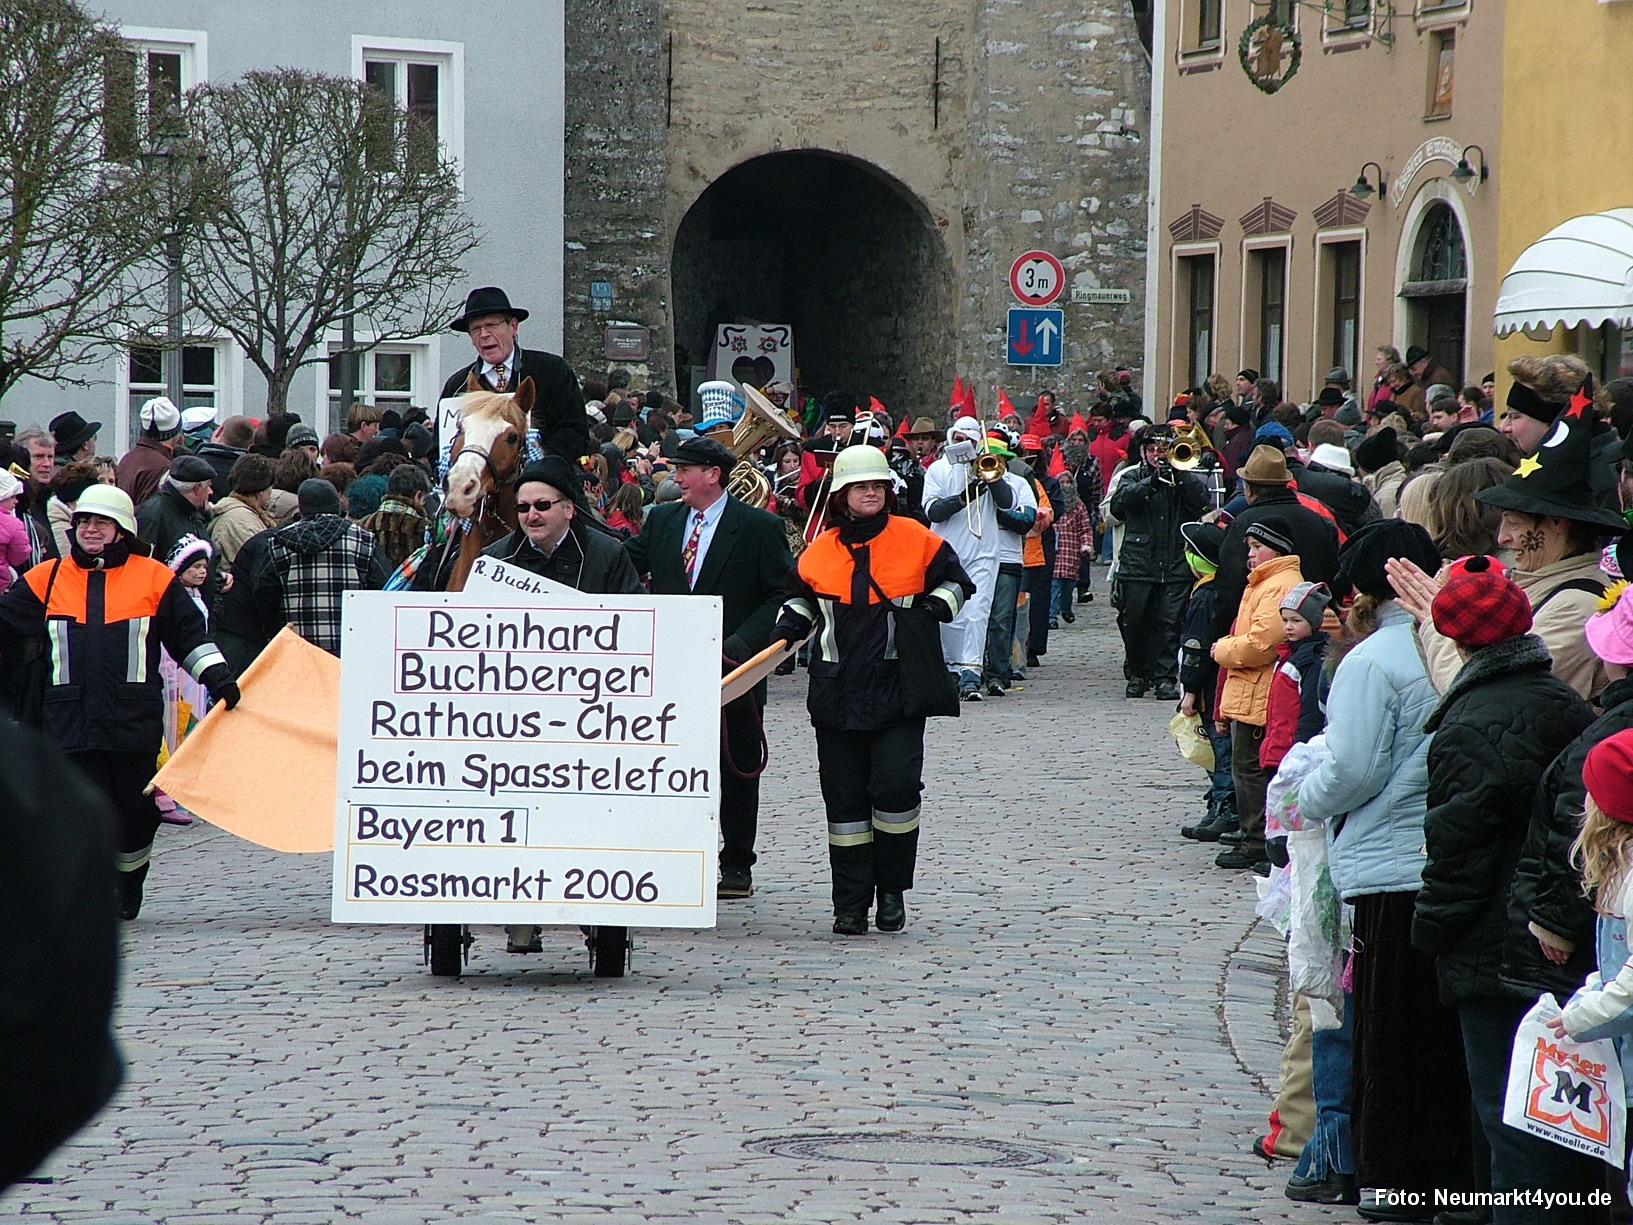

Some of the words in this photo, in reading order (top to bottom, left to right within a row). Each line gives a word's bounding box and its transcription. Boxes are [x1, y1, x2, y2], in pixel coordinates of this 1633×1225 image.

[1025, 267, 1035, 289] 3
[1037, 277, 1049, 289] m
[1075, 290, 1127, 302] Ringmauerweg
[474, 559, 488, 577] R.
[490, 564, 550, 594] Buchb
[427, 610, 621, 652] Reinhard
[400, 651, 650, 705] Buchberger
[357, 749, 446, 787] beim
[461, 753, 711, 797] Spasstelefon
[357, 806, 486, 850] Bayern
[499, 809, 518, 844] 1
[353, 864, 552, 901] Rossmarkt
[563, 868, 659, 903] 2006
[1551, 1070, 1593, 1114] M
[1527, 1122, 1606, 1157] www.mueller.de
